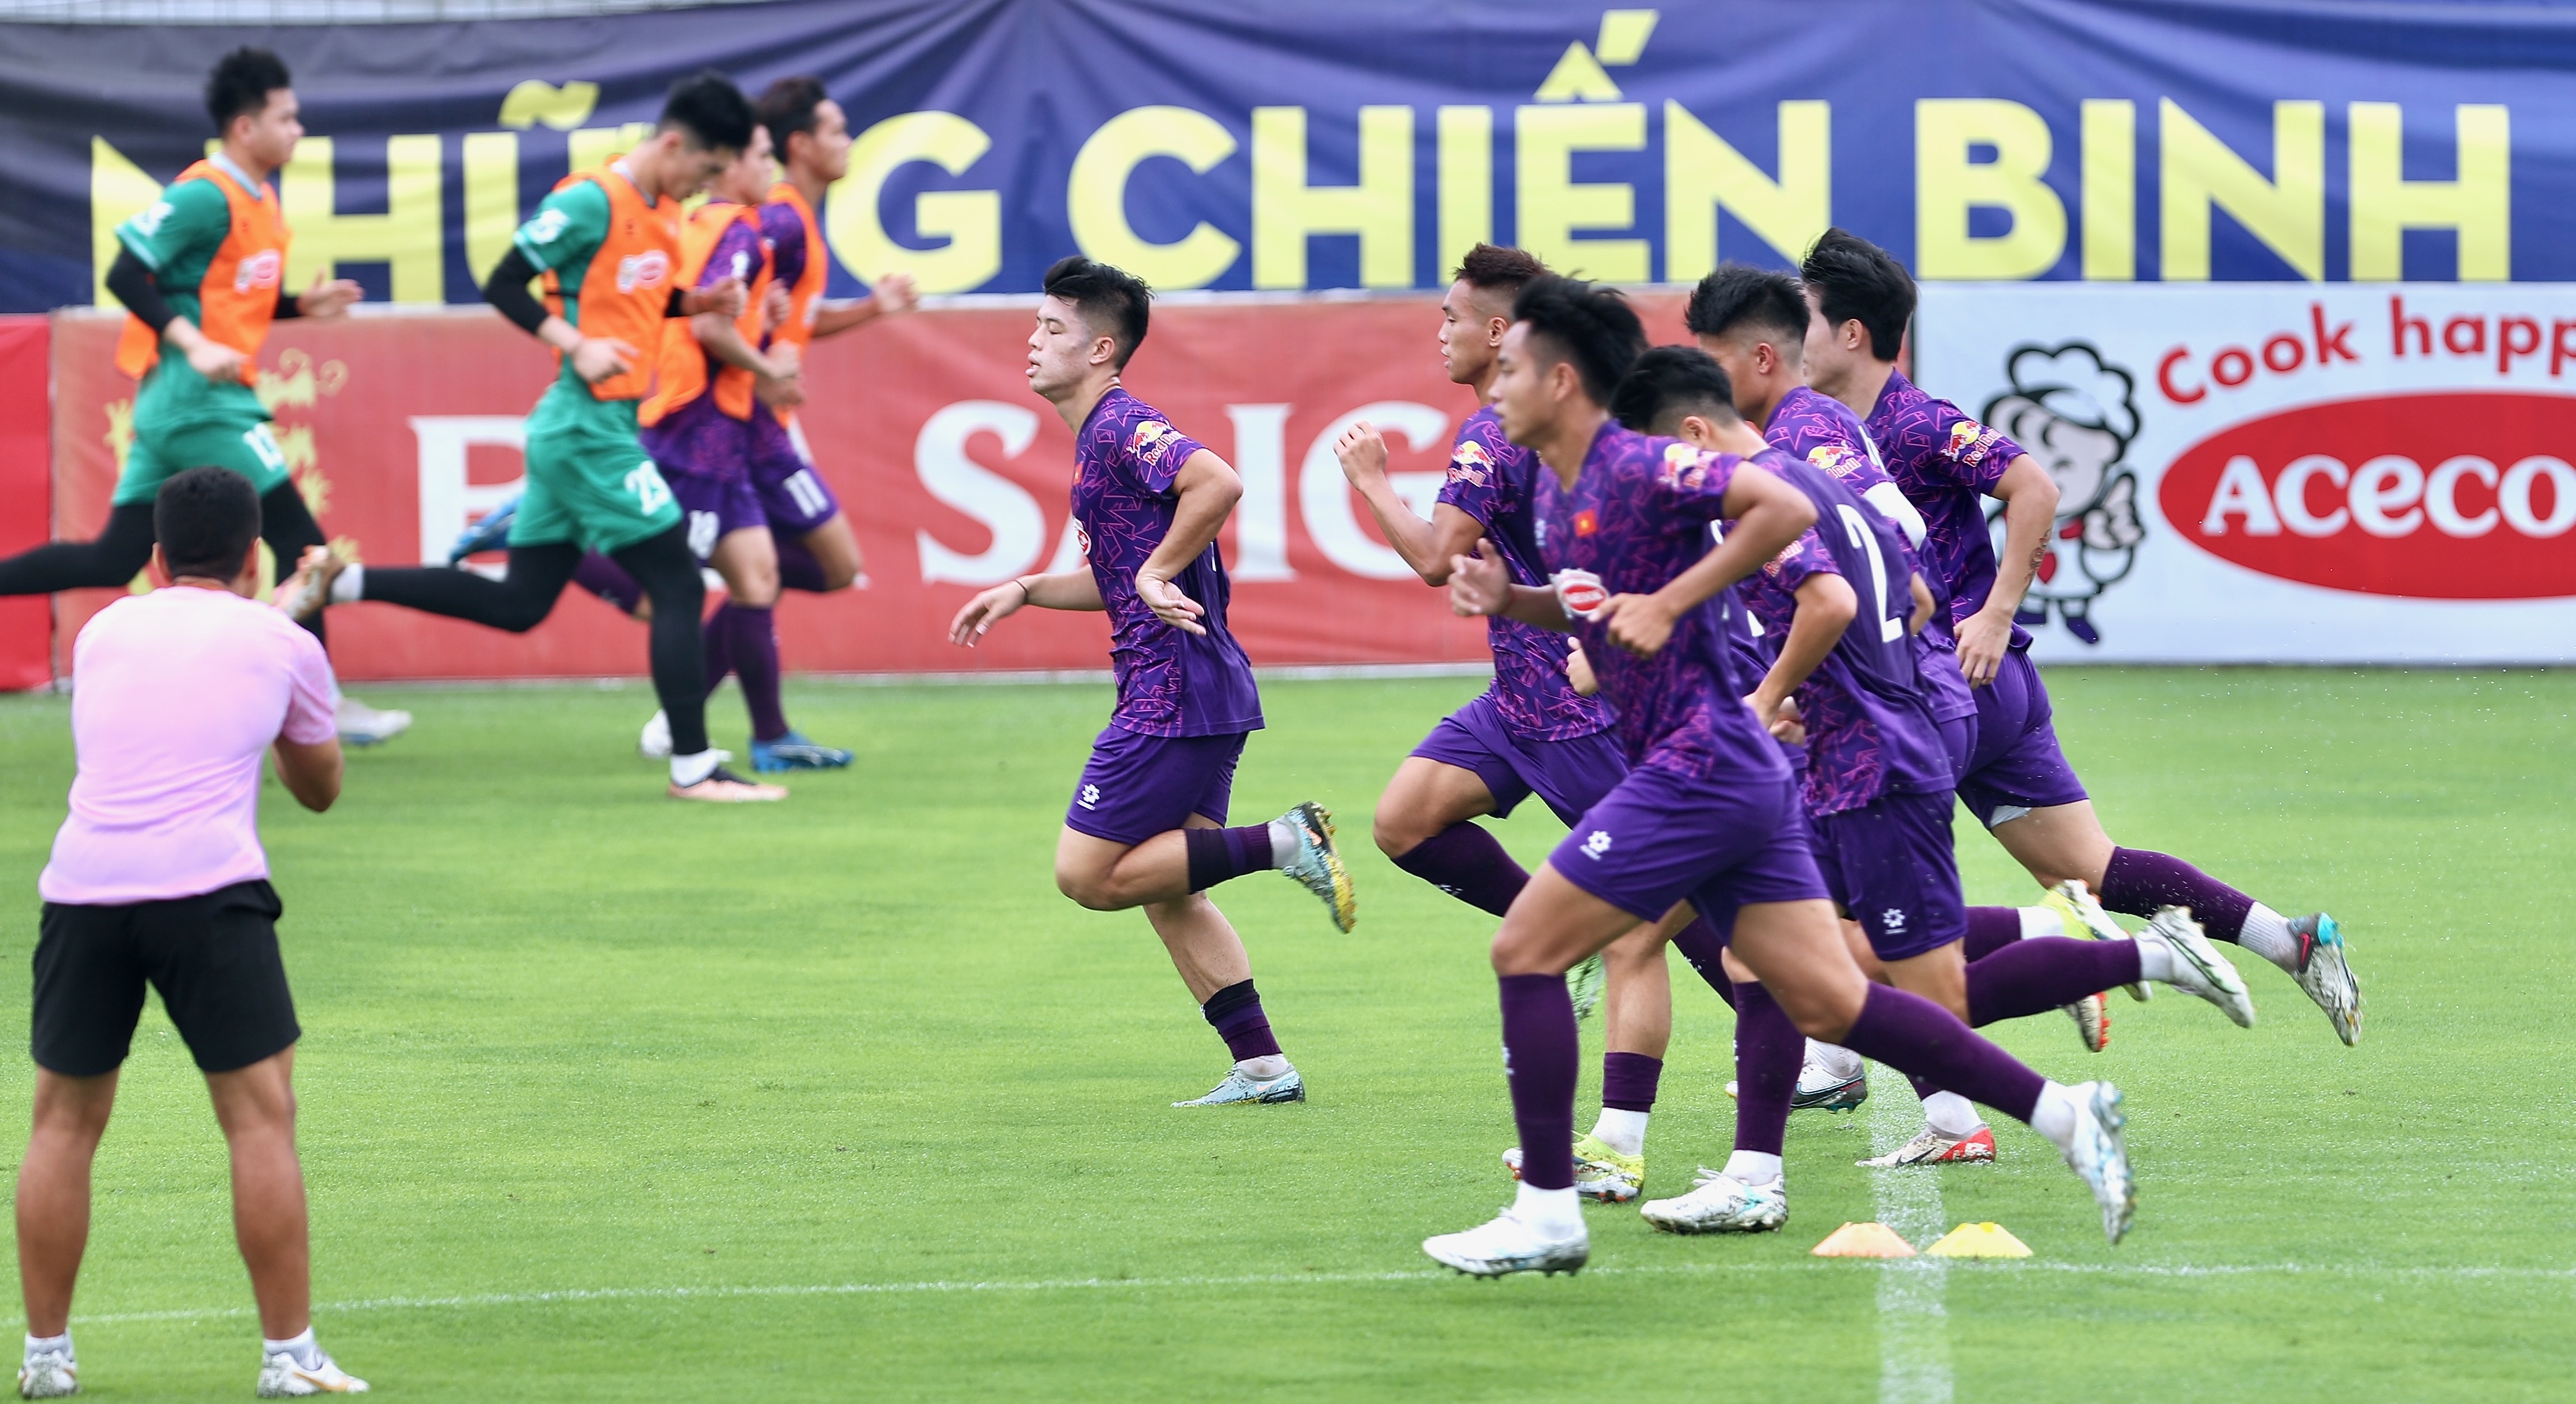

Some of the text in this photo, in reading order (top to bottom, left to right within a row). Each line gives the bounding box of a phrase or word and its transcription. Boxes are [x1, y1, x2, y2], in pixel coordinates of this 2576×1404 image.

[1067, 9, 1831, 290] CHIẾN
[1915, 96, 2511, 282] BINH
[2157, 302, 2359, 405] Cook
[1832, 457, 1862, 477] Bull
[1836, 503, 1903, 643] 2
